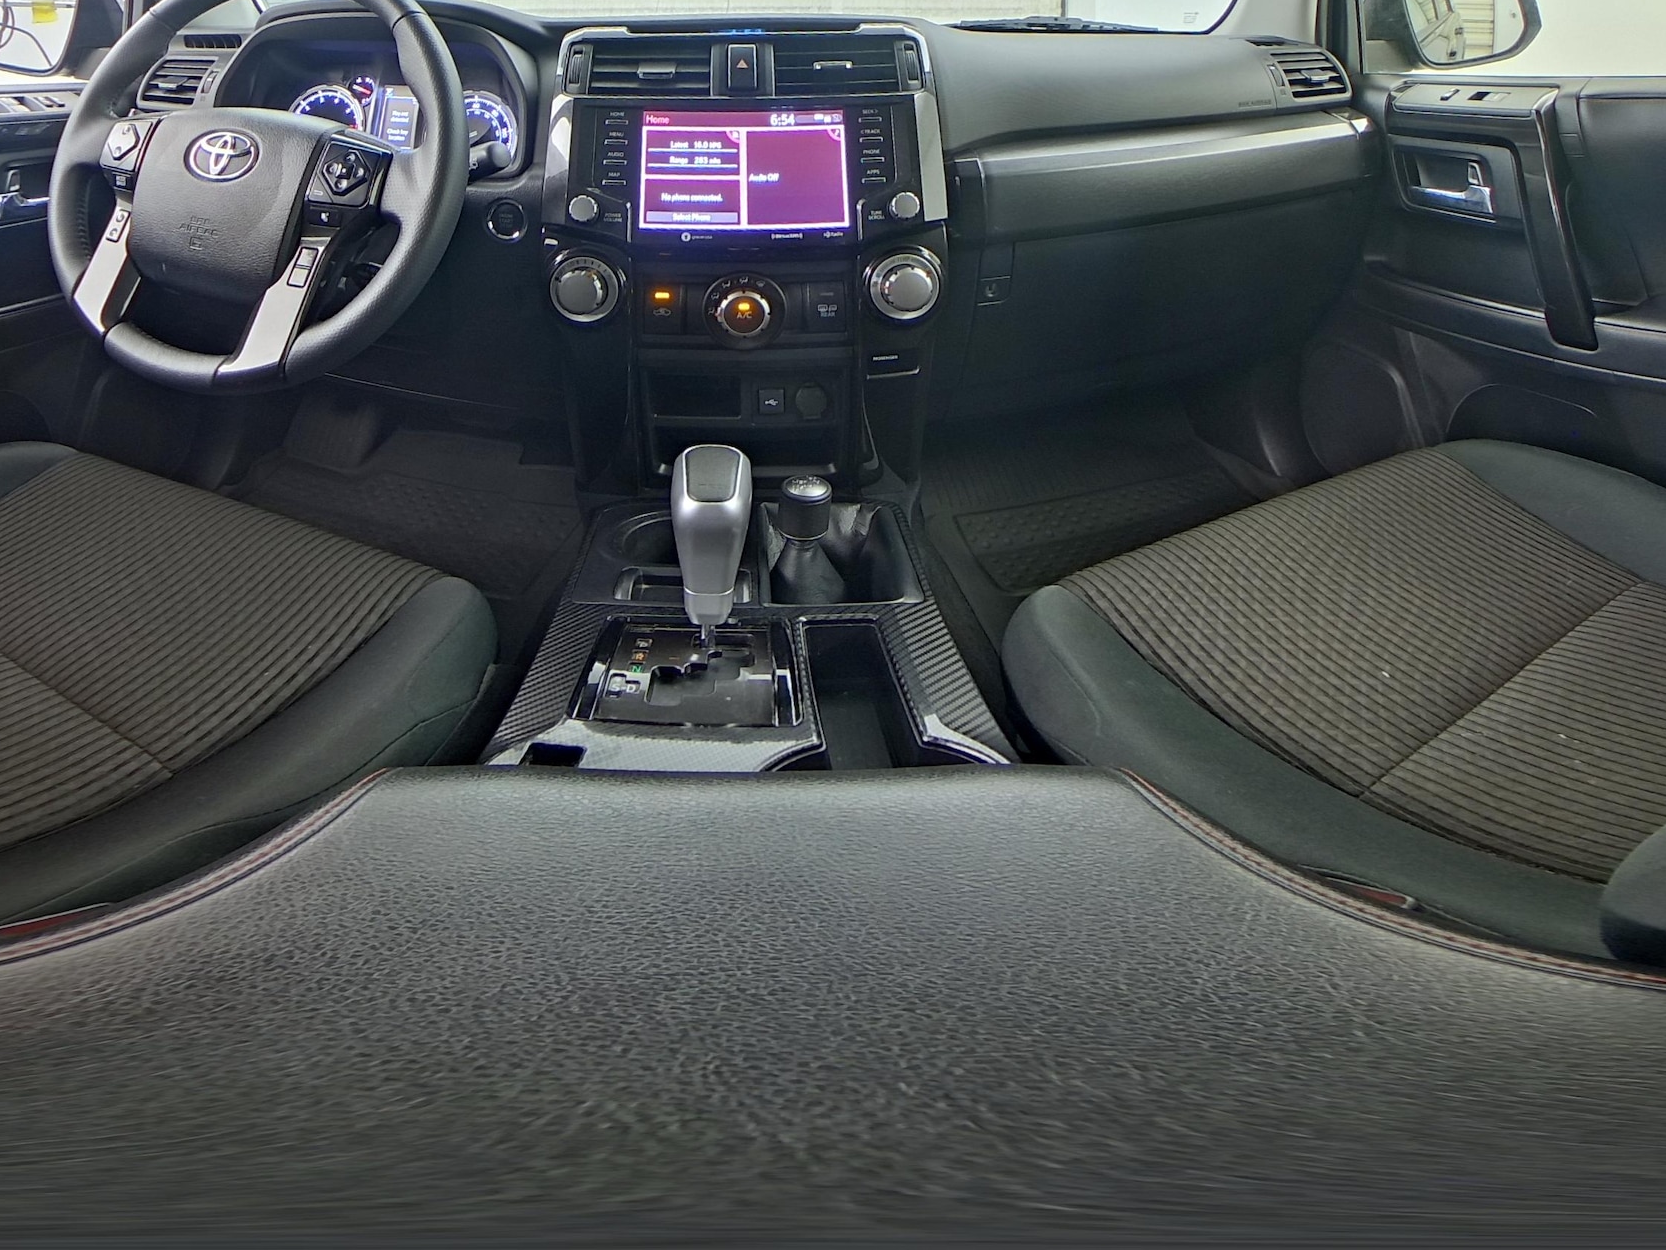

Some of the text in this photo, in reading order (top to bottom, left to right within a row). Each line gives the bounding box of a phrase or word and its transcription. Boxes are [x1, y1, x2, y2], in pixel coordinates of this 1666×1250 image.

[645, 114, 670, 125] Home
[769, 113, 796, 126] 6:54
[669, 156, 689, 165] Range
[767, 173, 780, 182] Off
[736, 311, 753, 319] A/C
[632, 664, 642, 673] N
